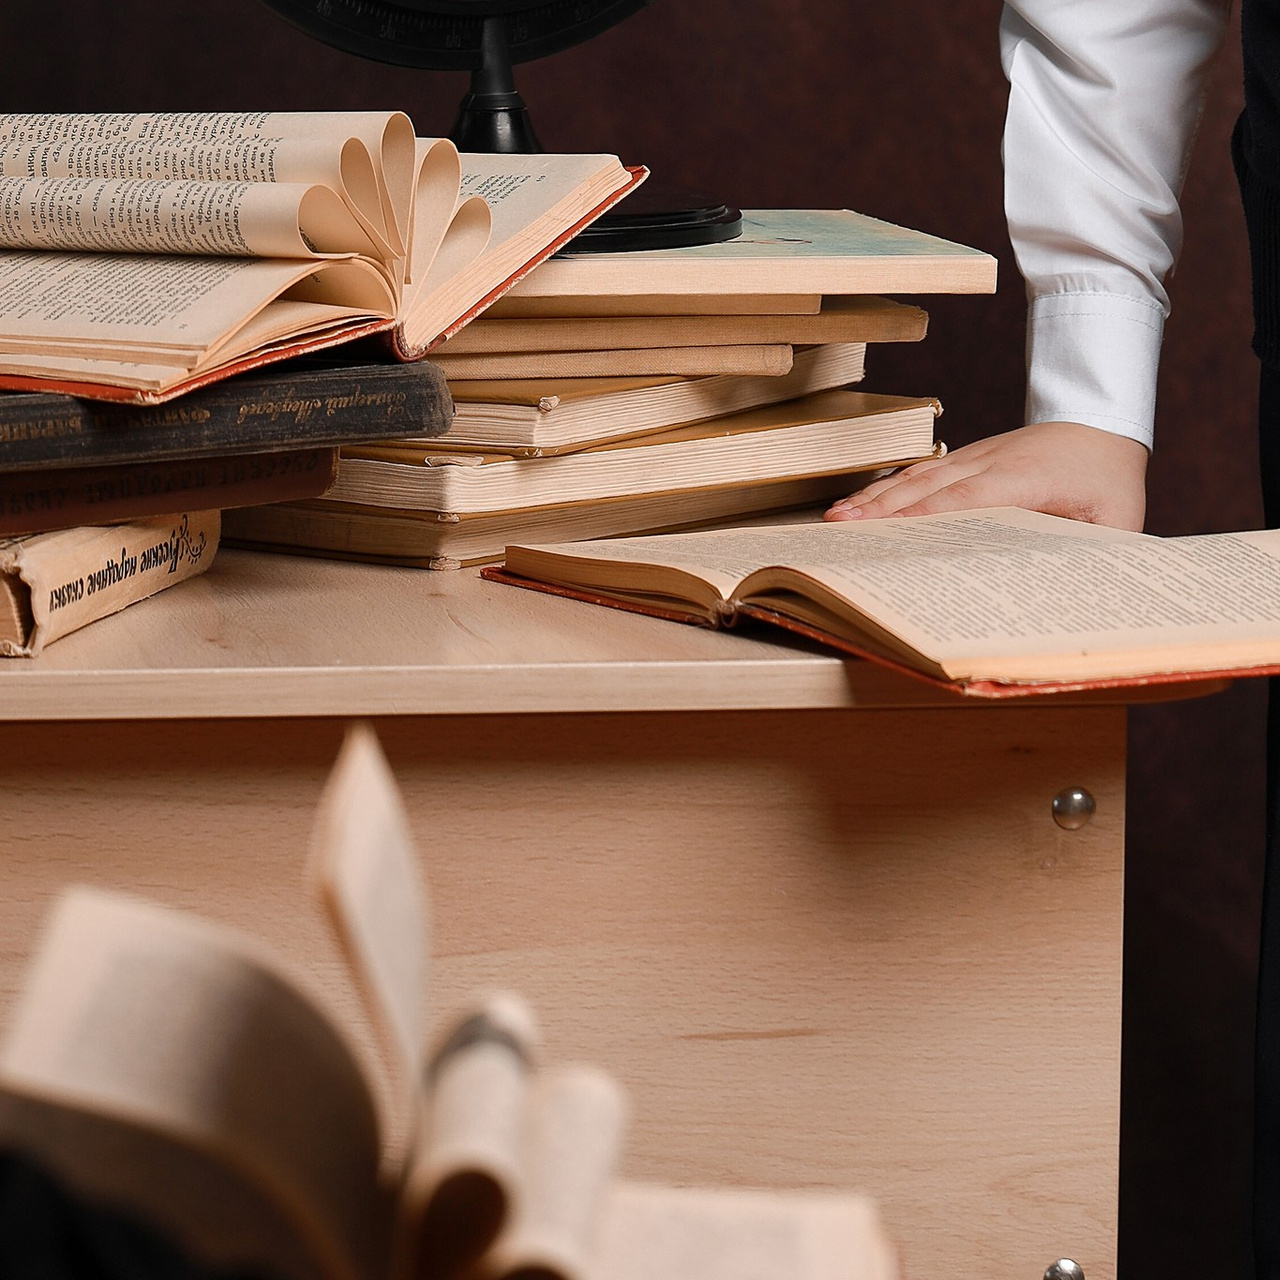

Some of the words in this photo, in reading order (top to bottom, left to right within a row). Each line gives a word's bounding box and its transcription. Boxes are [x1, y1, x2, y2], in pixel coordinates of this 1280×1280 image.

[87, 546, 138, 597] народные
[141, 529, 180, 575] Русские
[49, 577, 84, 613] сказки
